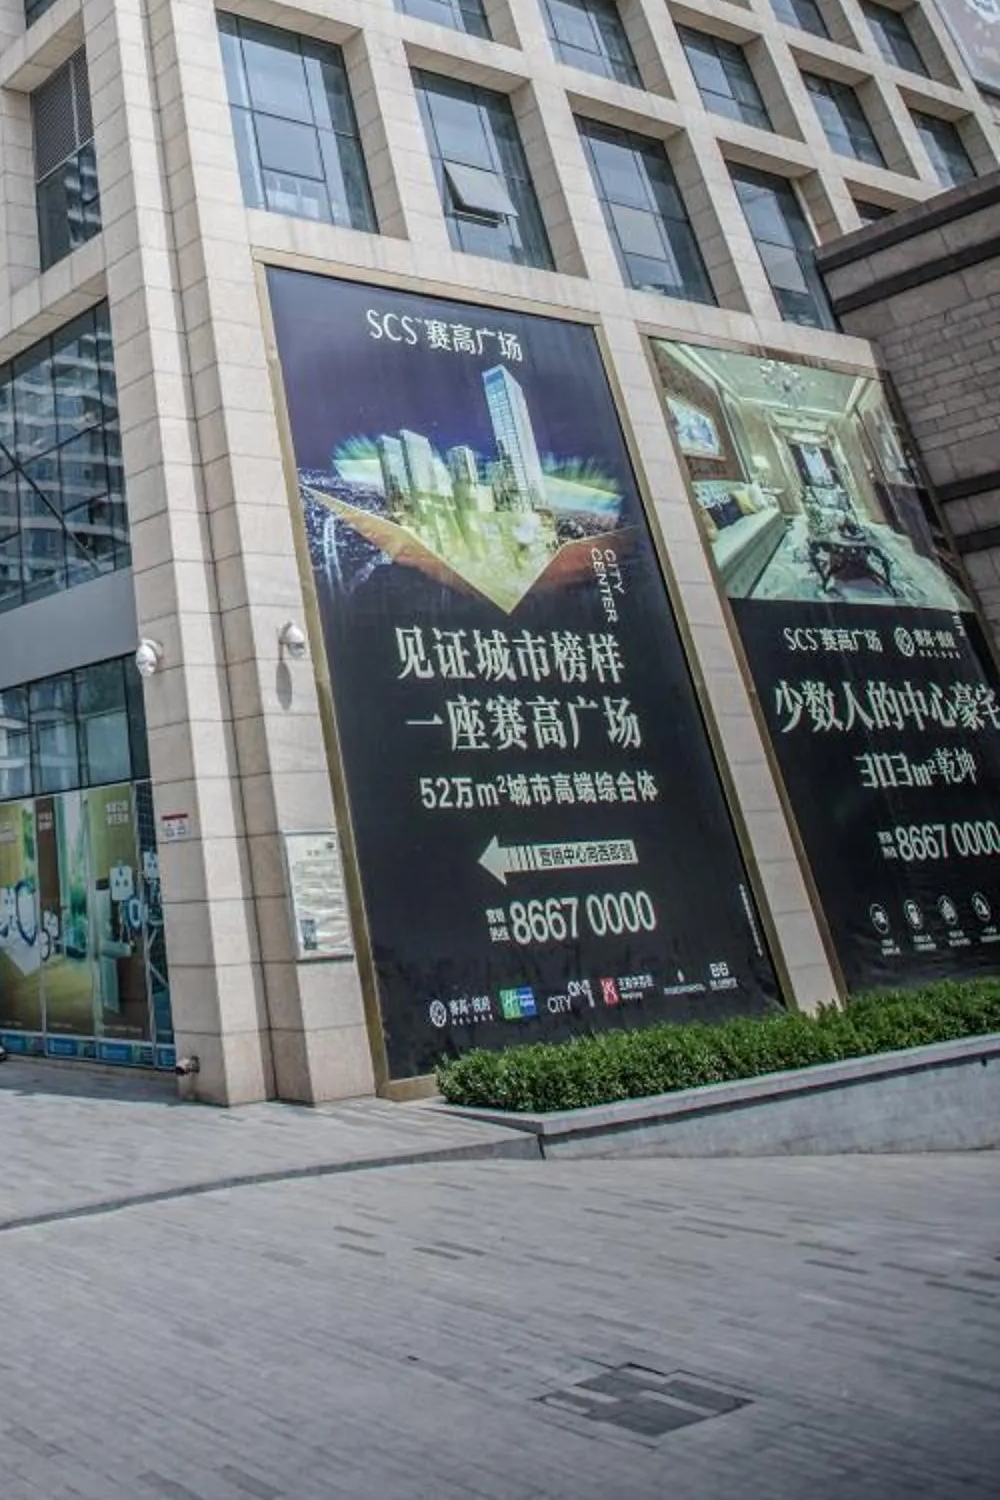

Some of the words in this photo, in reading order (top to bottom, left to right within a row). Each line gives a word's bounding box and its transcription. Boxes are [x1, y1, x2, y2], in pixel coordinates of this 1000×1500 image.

[366, 309, 419, 346] SCS
[423, 319, 523, 362] 赛高广场
[591, 547, 619, 623] CENTER
[604, 548, 625, 594] CITY
[395, 625, 625, 684] 见证城市榜样
[405, 694, 642, 750] 一座赛高广场
[774, 679, 1000, 734] 少数人的中心豪宅
[895, 822, 949, 862] 8667
[951, 820, 1000, 857] 0000
[509, 896, 581, 945] 8667
[587, 890, 657, 936] 0000
